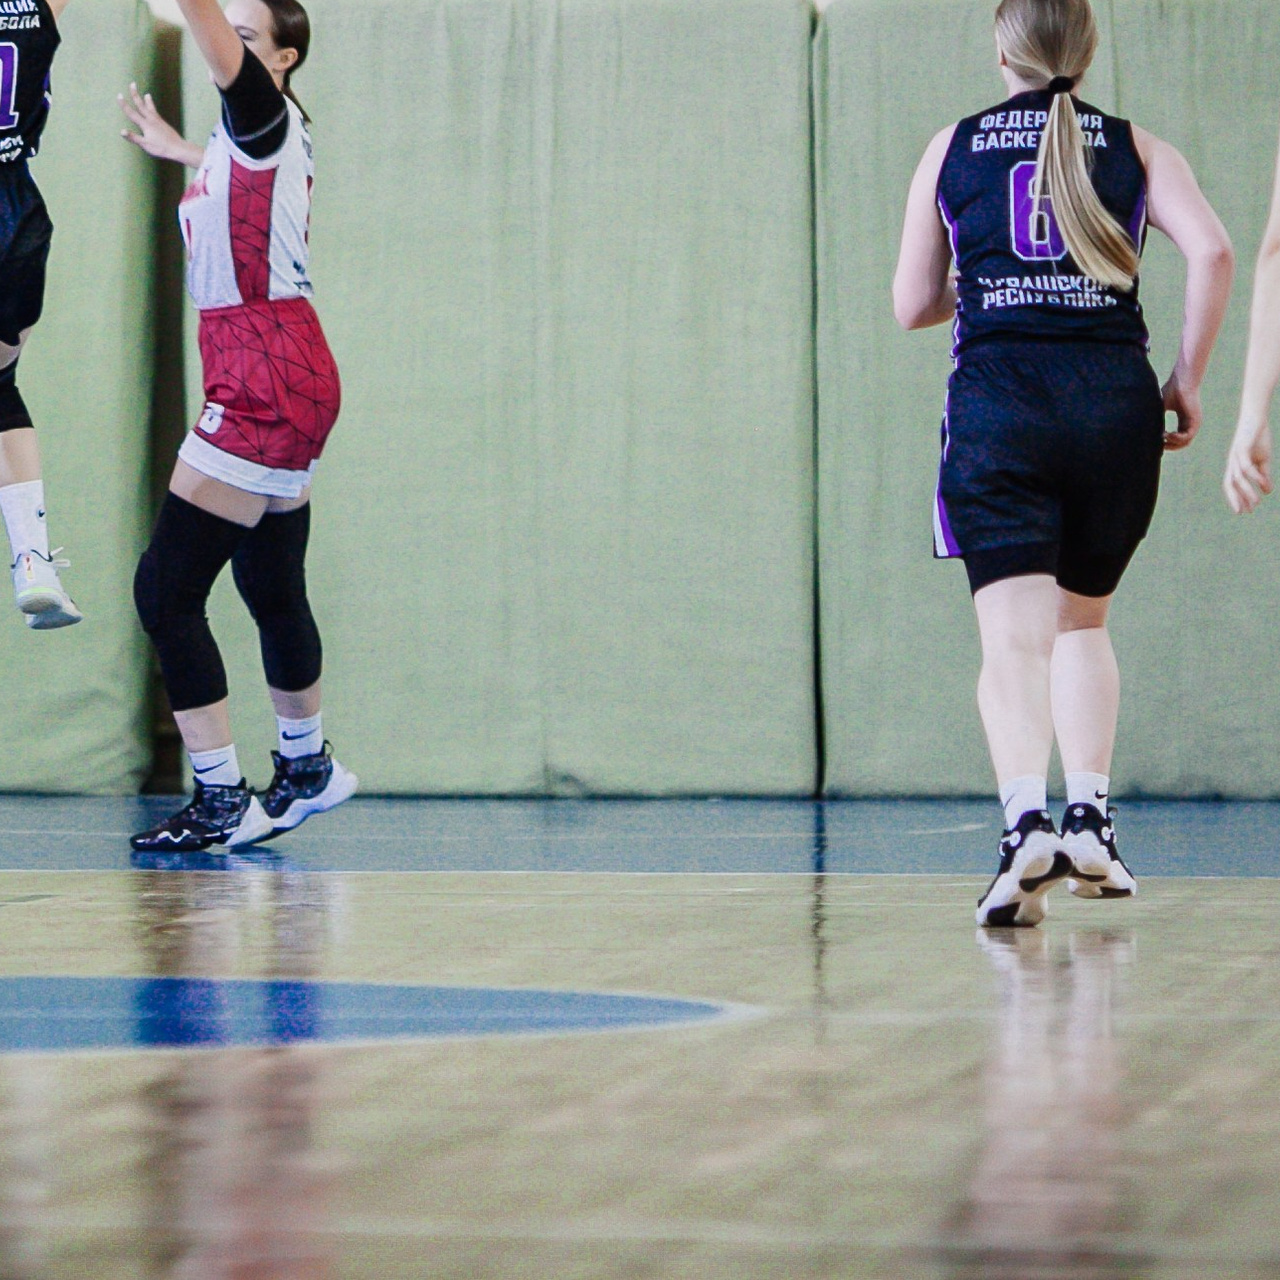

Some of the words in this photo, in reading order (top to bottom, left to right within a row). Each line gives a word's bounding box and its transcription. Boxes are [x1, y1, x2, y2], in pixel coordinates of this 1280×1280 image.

[979, 110, 1103, 131] ФЕДЕРИЯ
[971, 130, 1108, 153] БАСКЕЛА
[977, 274, 1110, 292] ЧУВАШСКО
